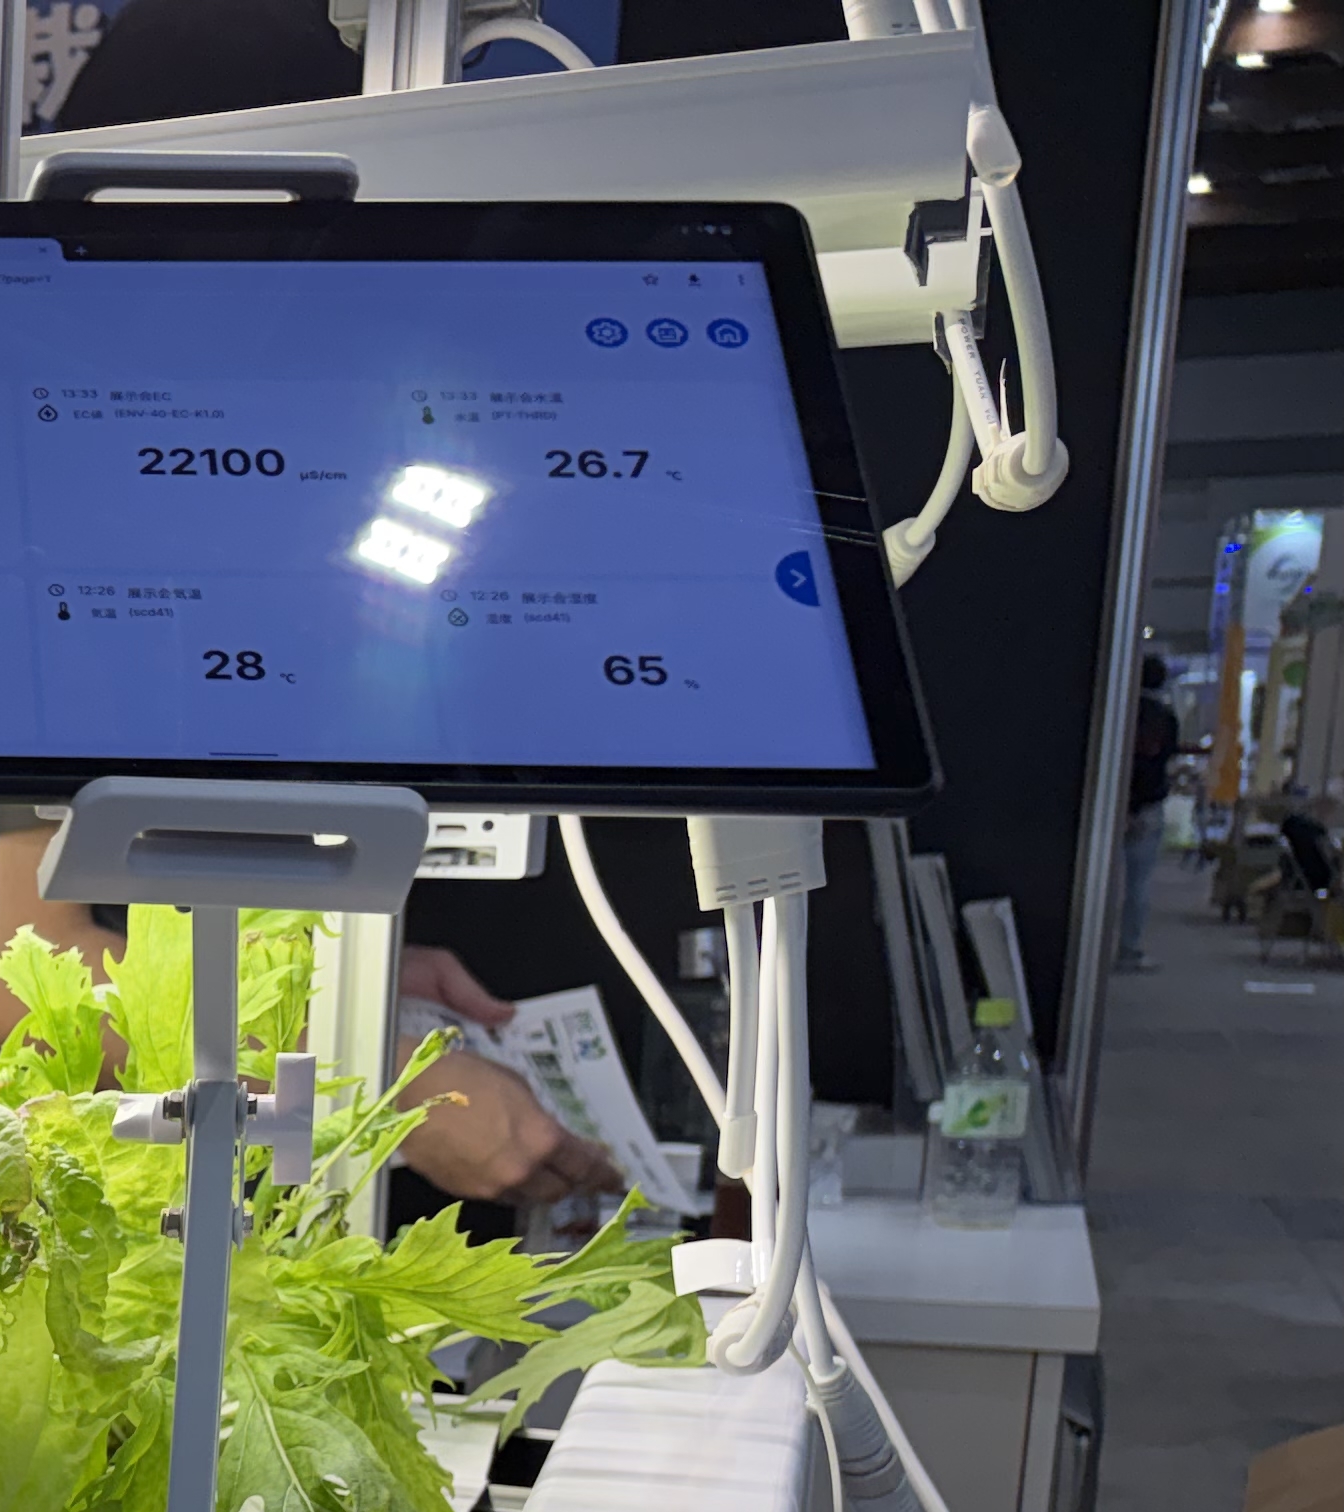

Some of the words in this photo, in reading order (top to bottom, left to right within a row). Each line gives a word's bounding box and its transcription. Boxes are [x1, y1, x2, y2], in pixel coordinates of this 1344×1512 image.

[959, 317, 975, 358] POWER
[61, 389, 98, 398] 13:33
[138, 447, 285, 477] 22100
[545, 450, 649, 479] 26.7
[78, 585, 115, 596] 12:26
[470, 590, 510, 601] 12:26
[129, 607, 174, 619] (scd41)
[203, 650, 265, 681] 28
[603, 655, 668, 687] 65
